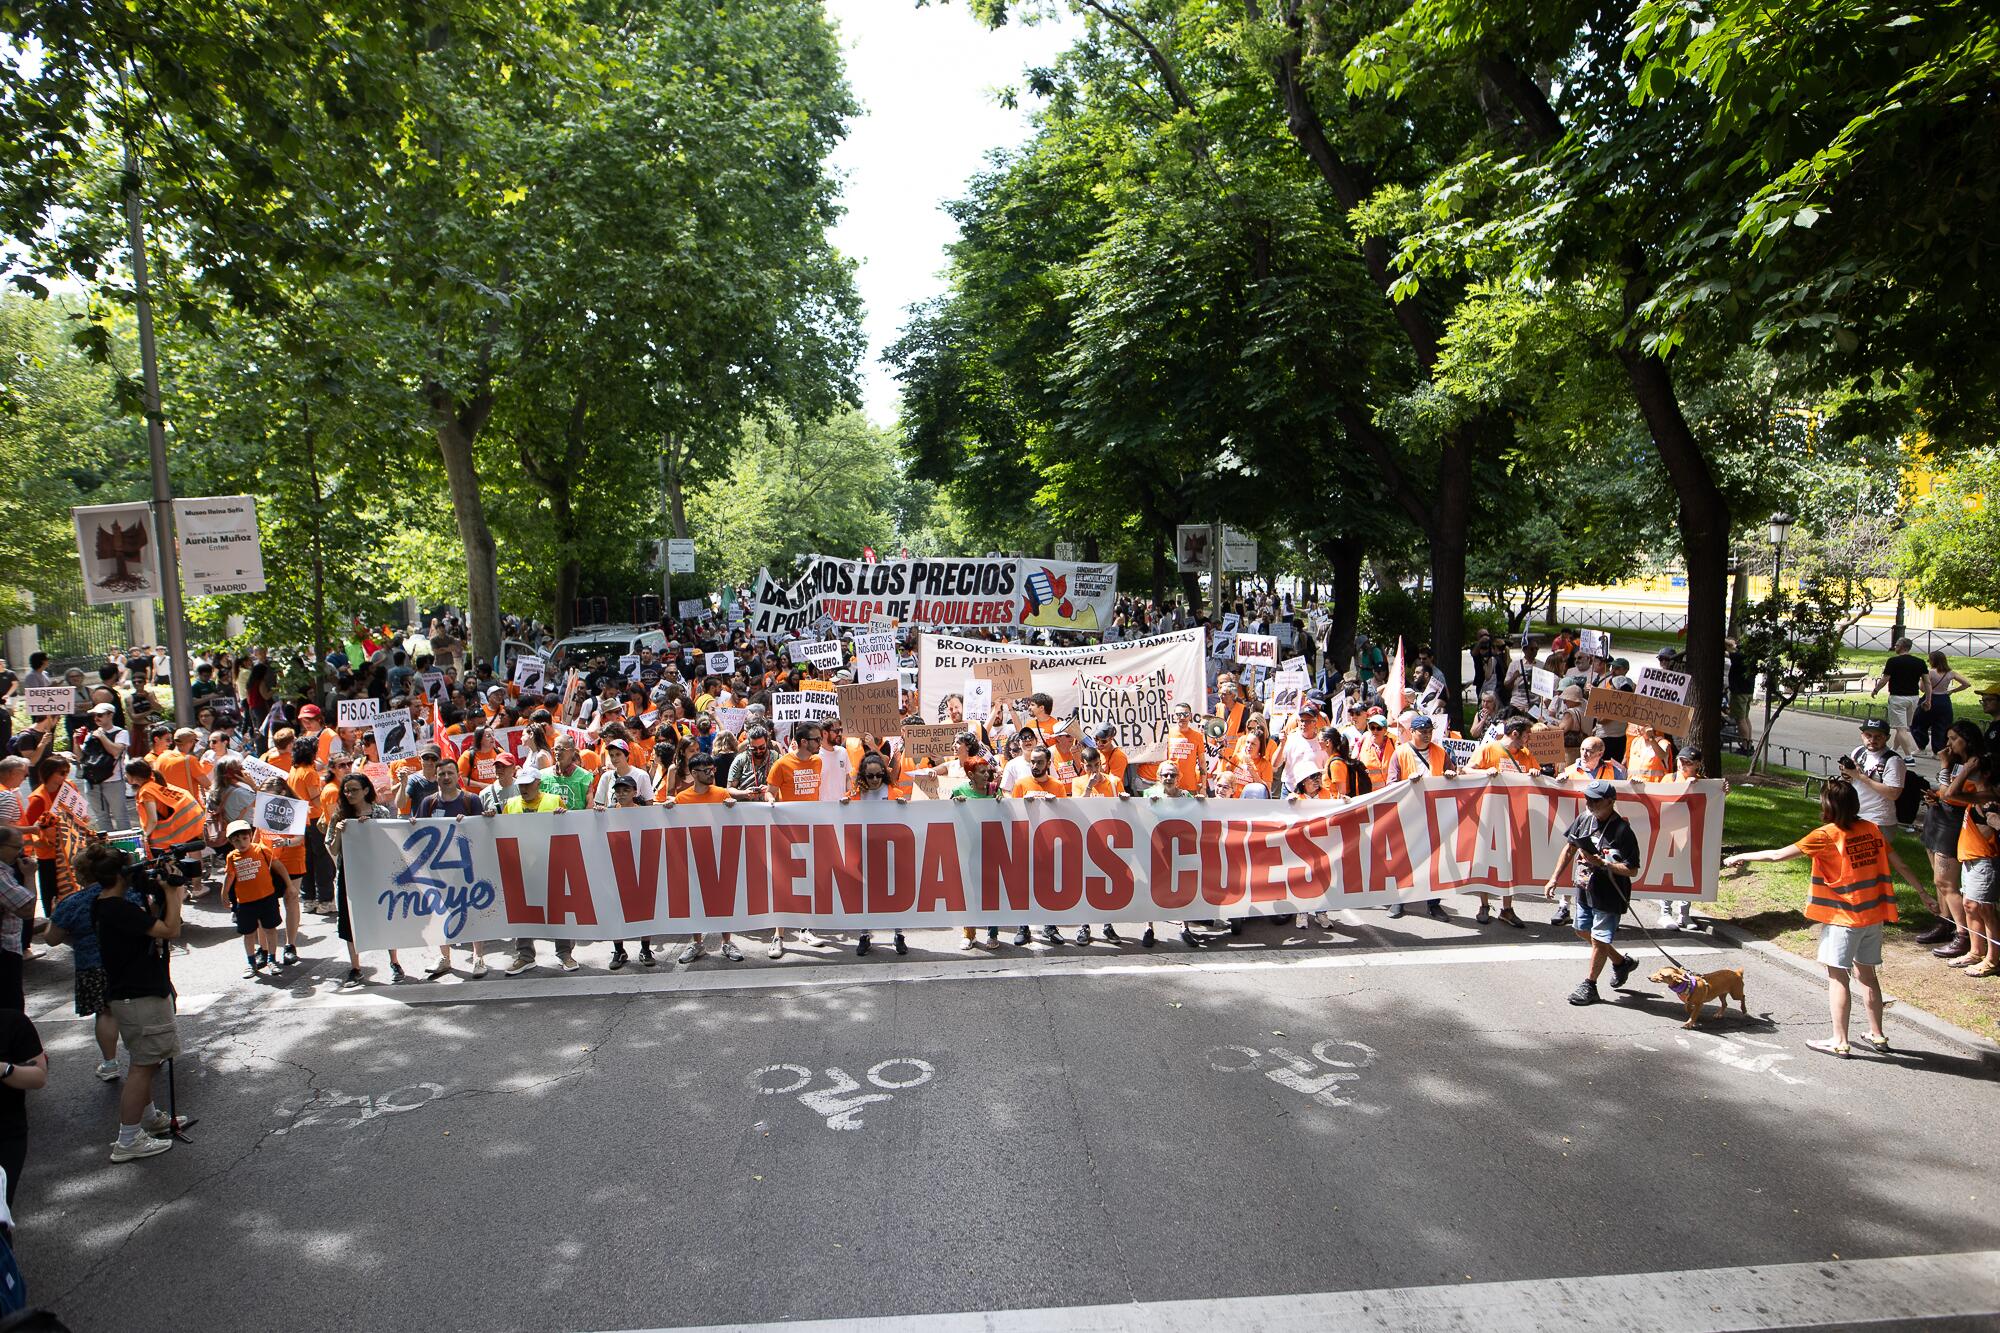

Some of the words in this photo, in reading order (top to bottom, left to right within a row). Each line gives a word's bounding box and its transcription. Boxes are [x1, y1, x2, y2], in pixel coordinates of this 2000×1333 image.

[220, 534, 252, 544] Muñoz
[856, 563, 906, 596] LOS
[909, 562, 1017, 596] PRECIOS
[213, 583, 247, 593] MADRID
[756, 610, 771, 632] A
[771, 609, 808, 633] POR
[886, 600, 911, 623] DE
[911, 599, 1015, 626] ALQUILERES
[858, 638, 866, 646] LA
[886, 643, 895, 651] LA
[804, 642, 838, 655] DERECHO
[865, 652, 891, 666] VIDA
[935, 656, 957, 668] DEL
[986, 663, 1013, 677] PLAN
[1643, 668, 1686, 687] DERECHO
[29, 688, 70, 698] DERECHO
[1137, 689, 1168, 707] POR
[1612, 691, 1622, 700] EN
[1640, 684, 1647, 695] A
[1649, 686, 1681, 703] TECHO.
[804, 708, 810, 719] A
[850, 705, 856, 713] Y
[862, 702, 892, 715] MENOS
[373, 713, 384, 721] Con
[777, 710, 783, 720] A
[374, 719, 397, 729] engorda
[846, 717, 897, 734] BUITRES
[907, 728, 932, 738] FUERA
[1148, 720, 1170, 743] YA
[382, 754, 398, 762] BANCO
[553, 786, 569, 795] PAH
[266, 802, 293, 815] STOP
[396, 823, 475, 888] 24
[495, 834, 598, 926] LA
[607, 822, 967, 924] VIVIENDA
[981, 818, 1134, 912] NOS
[1150, 801, 1415, 909] CUESTA
[1434, 793, 1513, 886] LA
[1528, 793, 1695, 888] VDA
[378, 879, 495, 938] mayo
